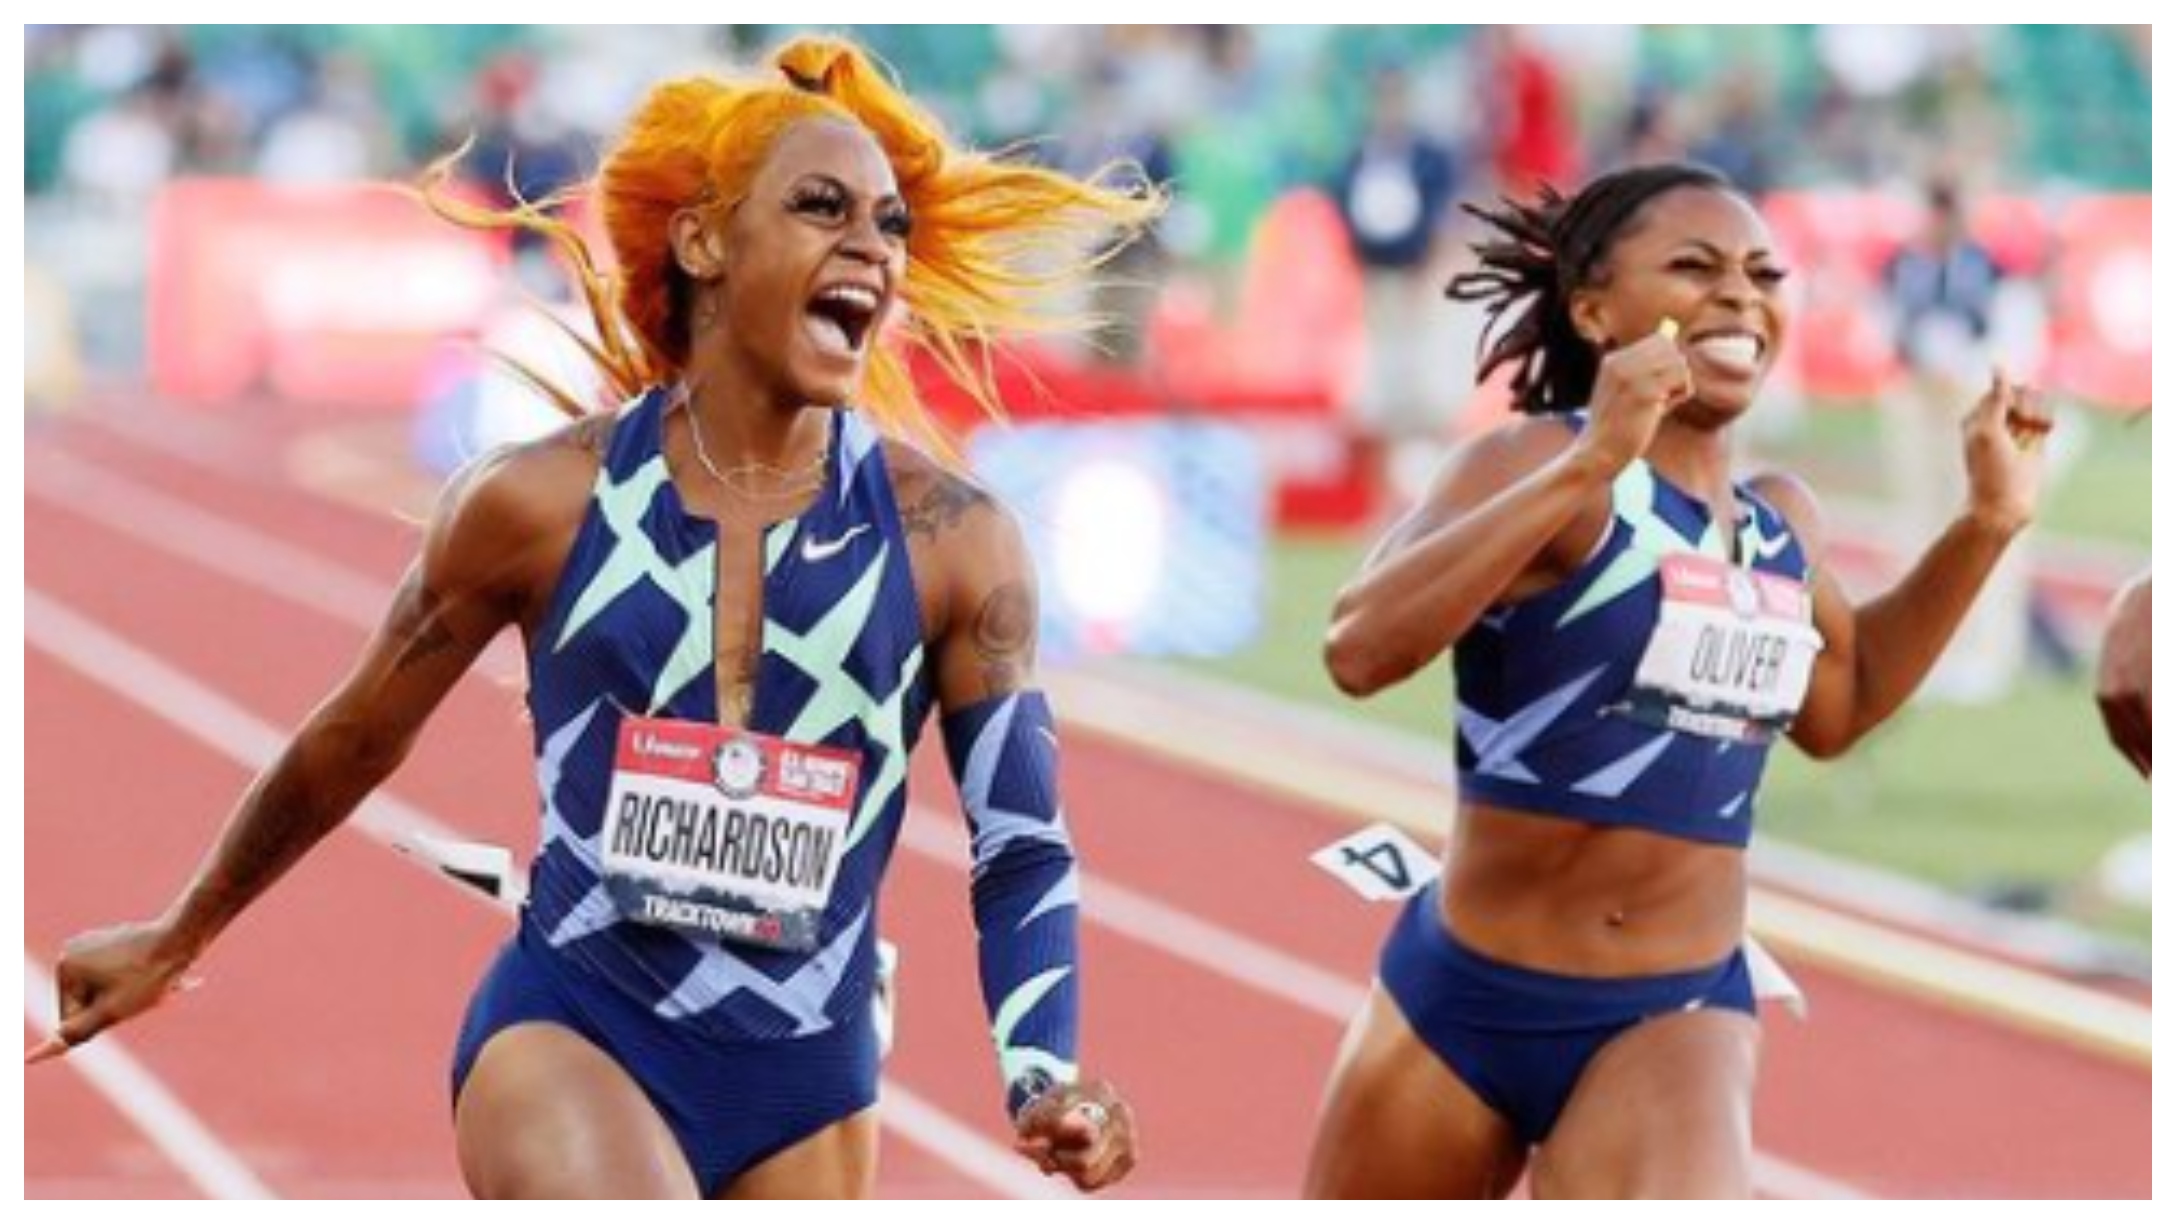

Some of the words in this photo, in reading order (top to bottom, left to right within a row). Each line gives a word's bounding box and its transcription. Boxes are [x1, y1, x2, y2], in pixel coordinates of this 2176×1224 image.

[1689, 624, 1787, 691] OLIVER
[612, 791, 833, 892] RICHARDSON
[1341, 842, 1411, 889] 4
